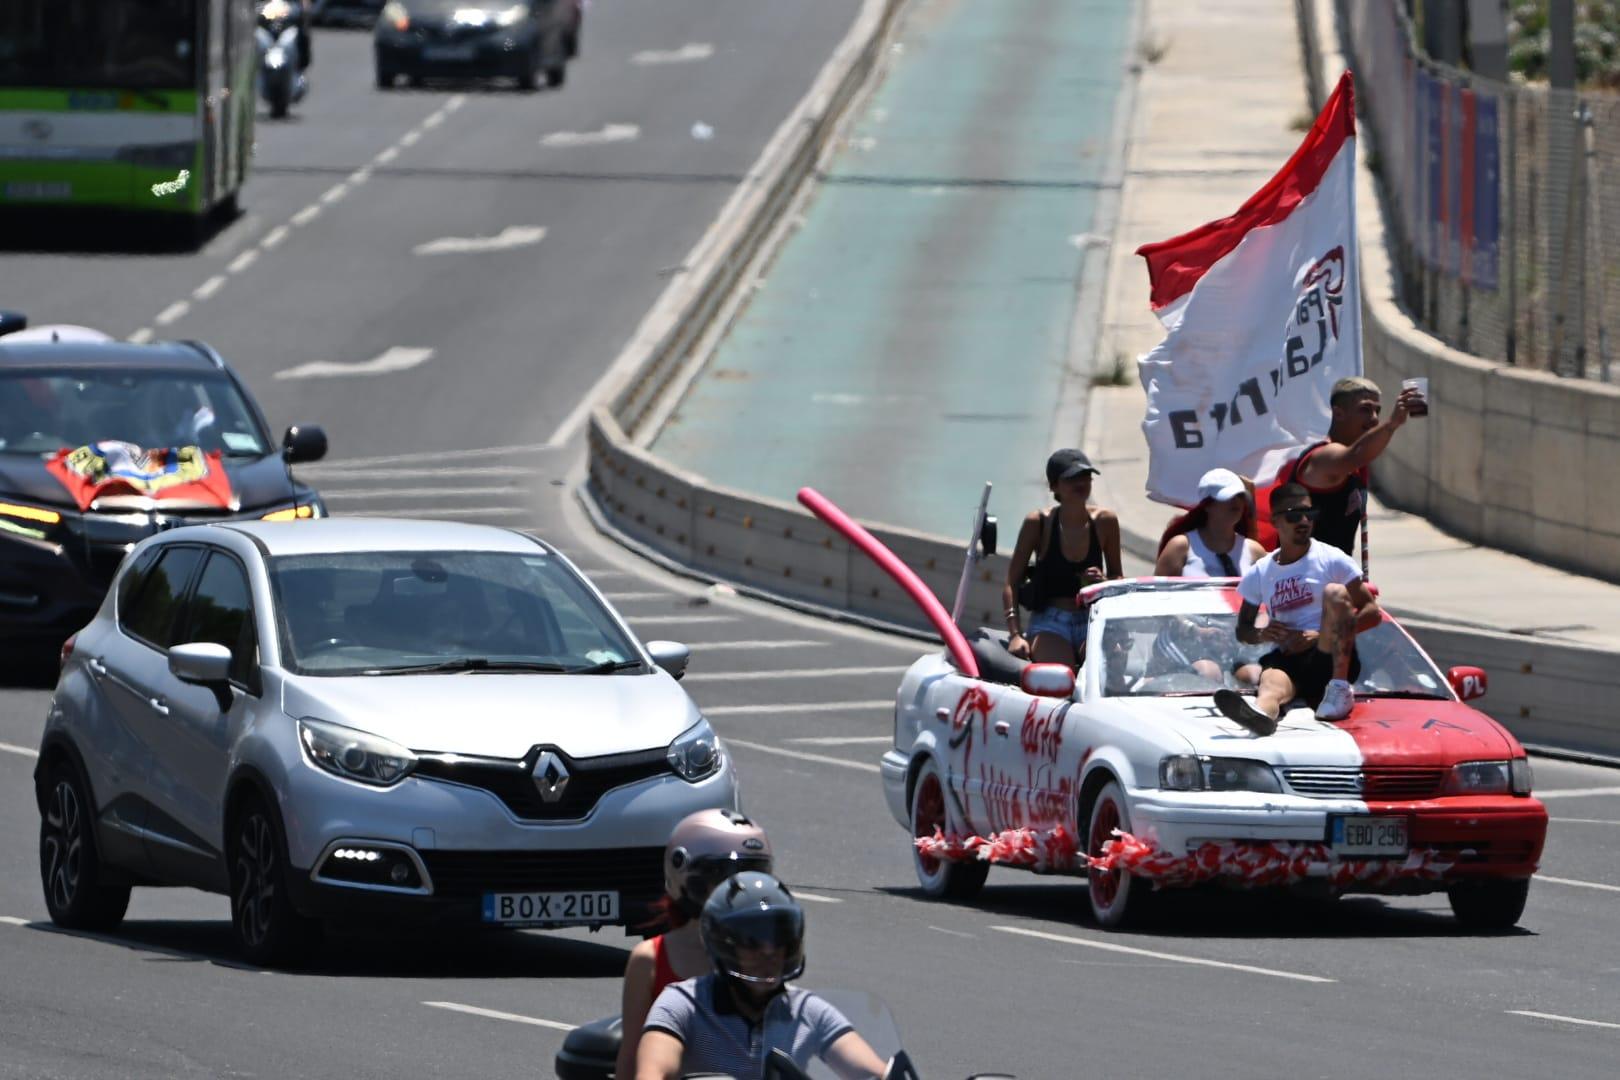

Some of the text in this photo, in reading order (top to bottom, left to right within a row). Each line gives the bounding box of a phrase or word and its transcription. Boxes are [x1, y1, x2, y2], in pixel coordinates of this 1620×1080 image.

[1378, 824, 1404, 846] 296
[500, 894, 611, 919] BOX 200
